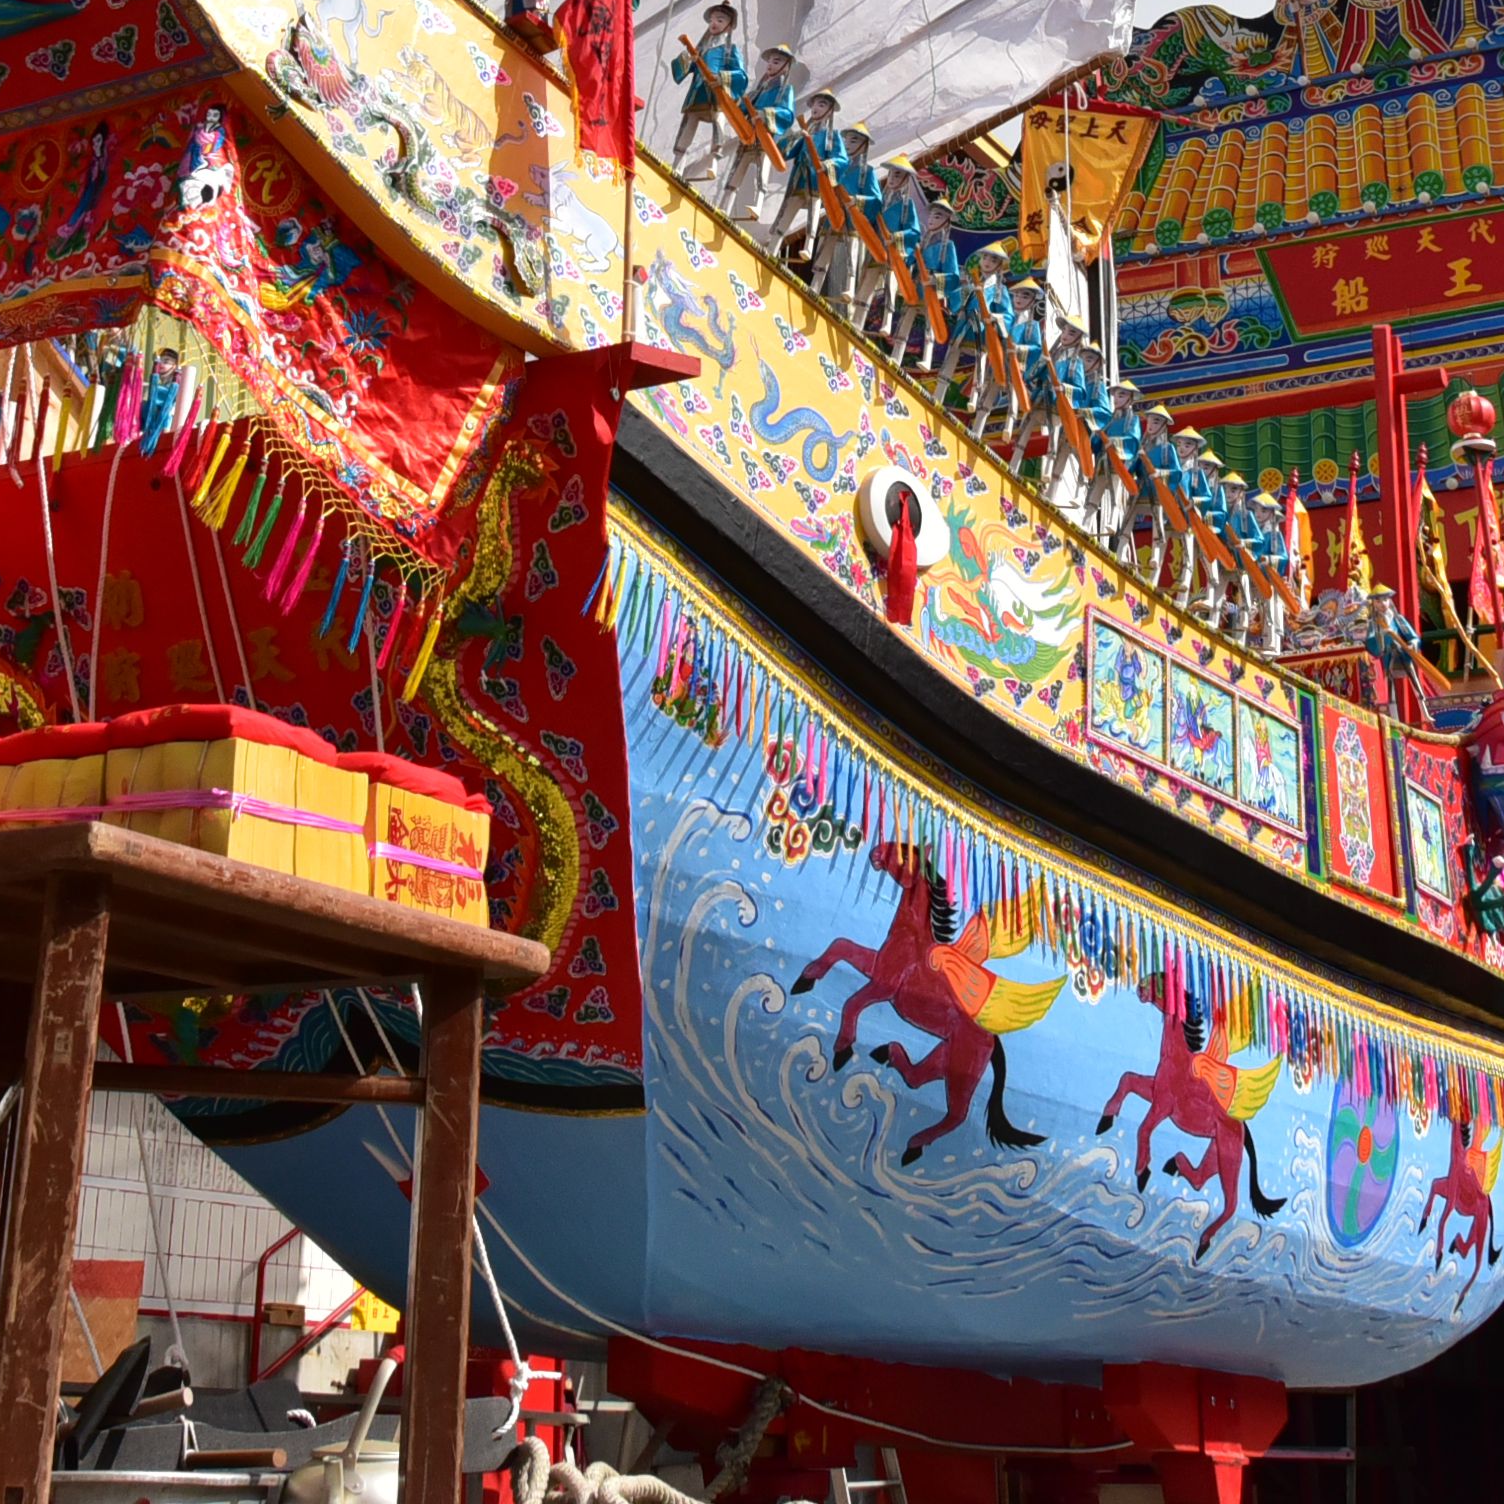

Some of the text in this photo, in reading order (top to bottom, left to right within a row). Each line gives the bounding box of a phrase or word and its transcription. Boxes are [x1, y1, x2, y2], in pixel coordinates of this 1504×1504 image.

[1311, 218, 1496, 269] 代天巡狩
[1331, 257, 1483, 316] 王船
